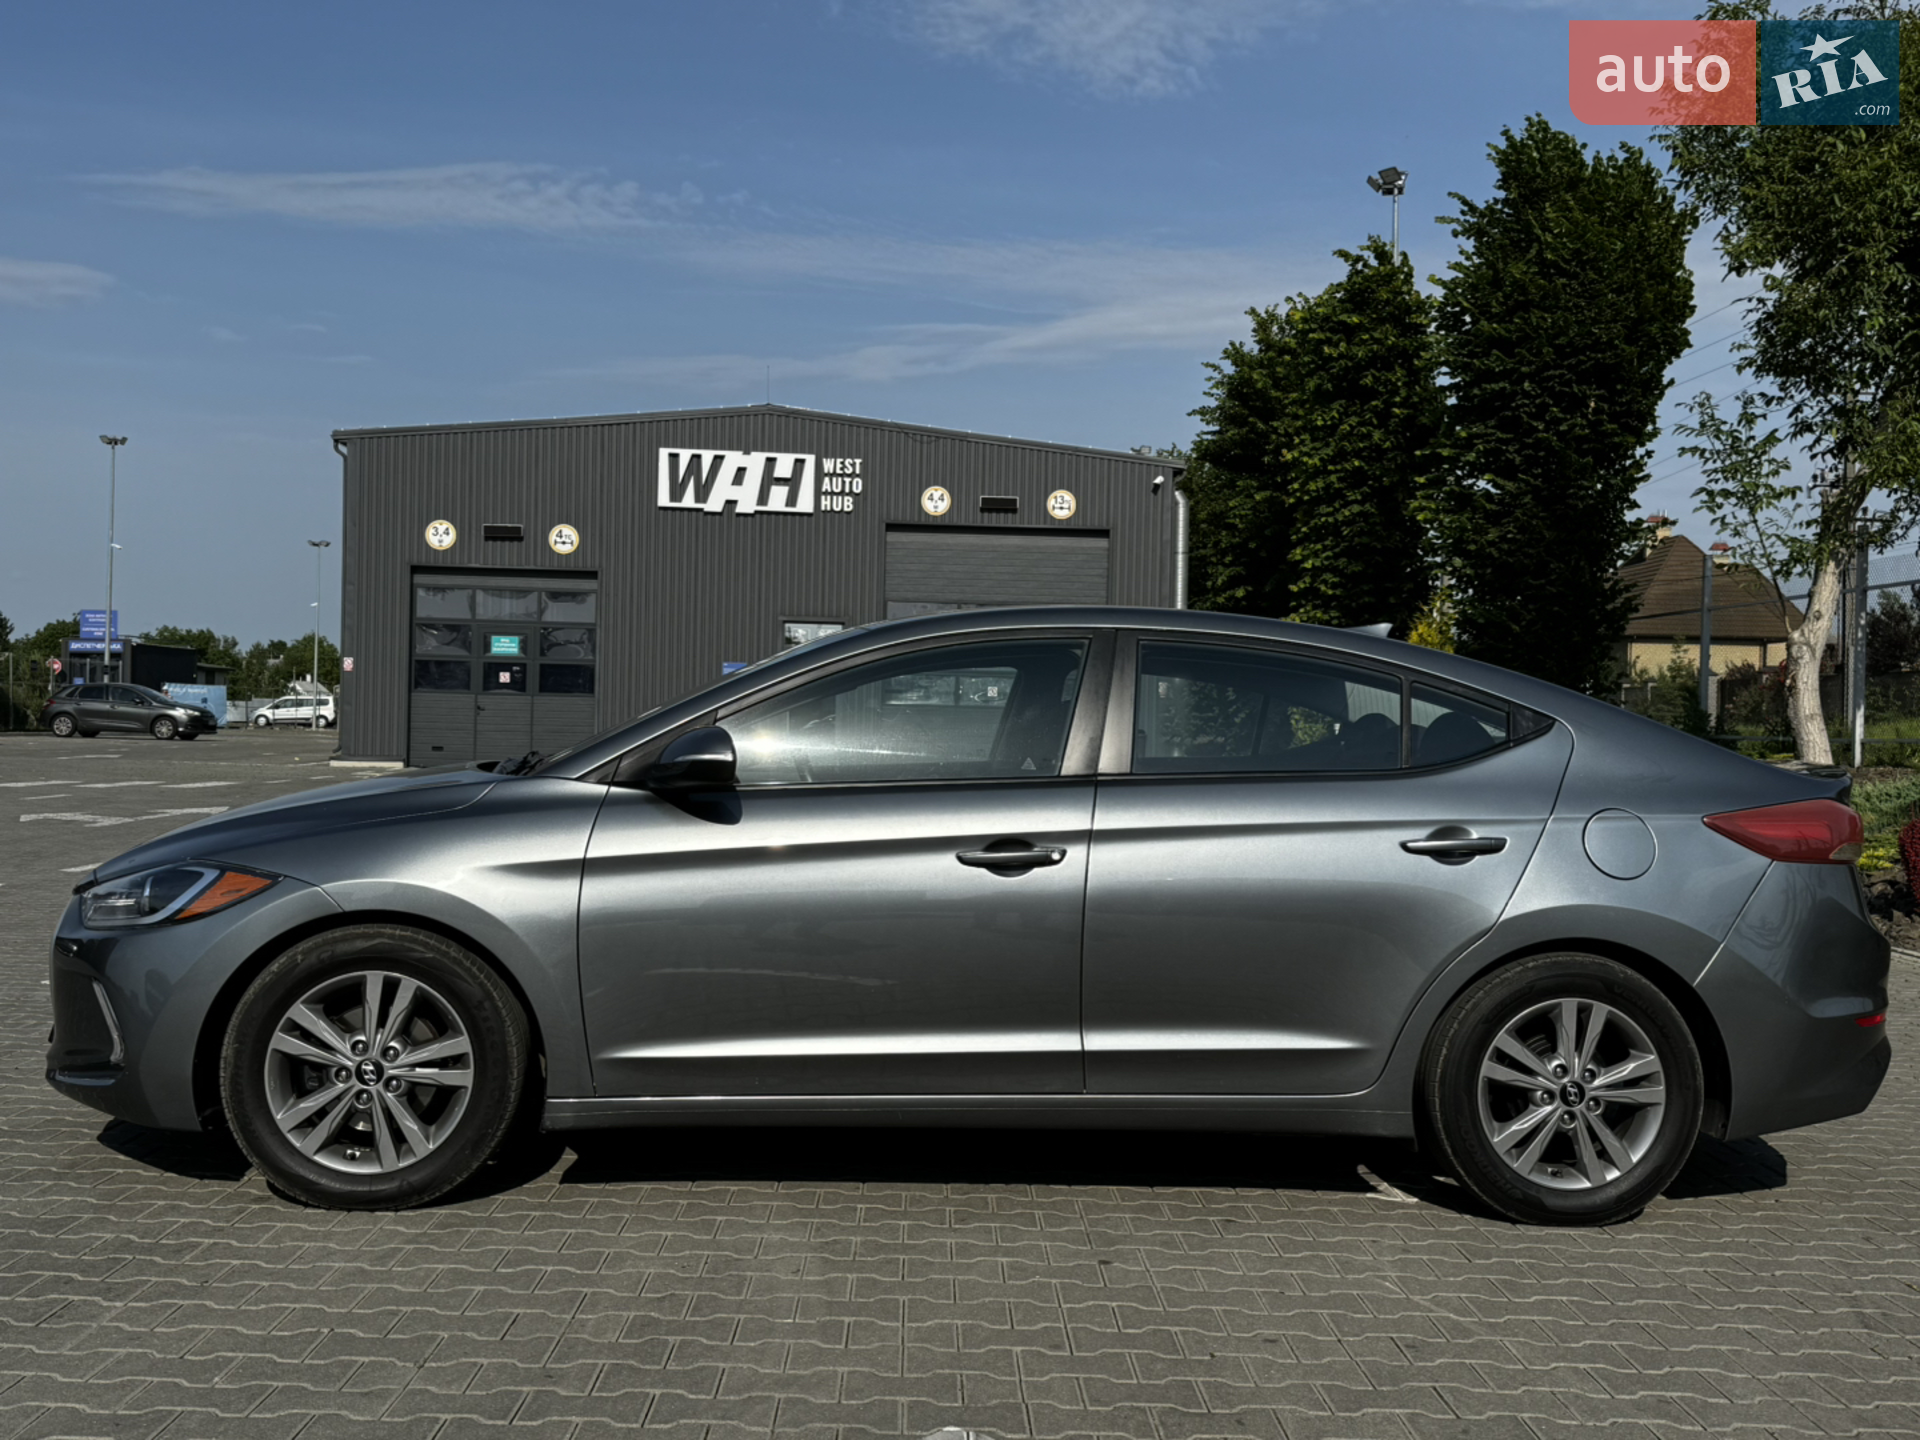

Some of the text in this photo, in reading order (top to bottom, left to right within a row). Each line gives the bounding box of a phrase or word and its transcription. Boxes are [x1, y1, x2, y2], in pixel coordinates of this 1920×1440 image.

[822, 458, 863, 474] WEST
[660, 449, 815, 514] WAH
[821, 477, 863, 493] AUTO
[820, 495, 854, 512] HUB
[1053, 495, 1065, 505] 13
